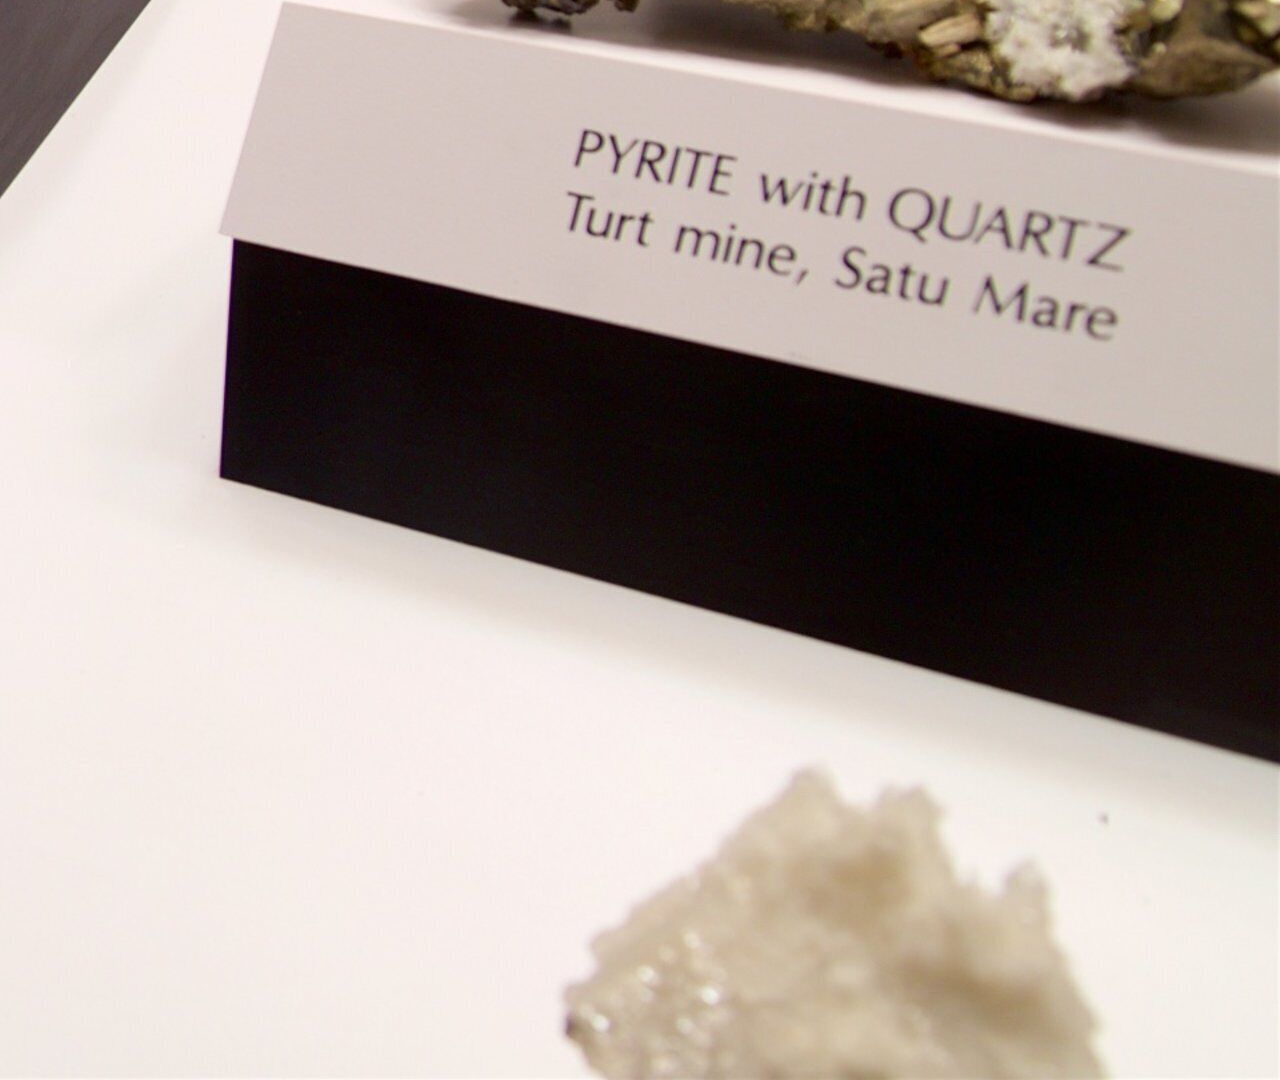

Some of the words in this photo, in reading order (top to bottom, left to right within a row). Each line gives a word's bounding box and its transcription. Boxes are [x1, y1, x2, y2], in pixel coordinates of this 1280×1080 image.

[567, 191, 653, 247] Turt
[674, 225, 808, 284] mine,
[834, 246, 949, 306] Satu
[974, 275, 1118, 339] Mare
[573, 128, 737, 196] PYRITE
[760, 173, 867, 221] with
[887, 188, 1130, 270] QUARTZ
